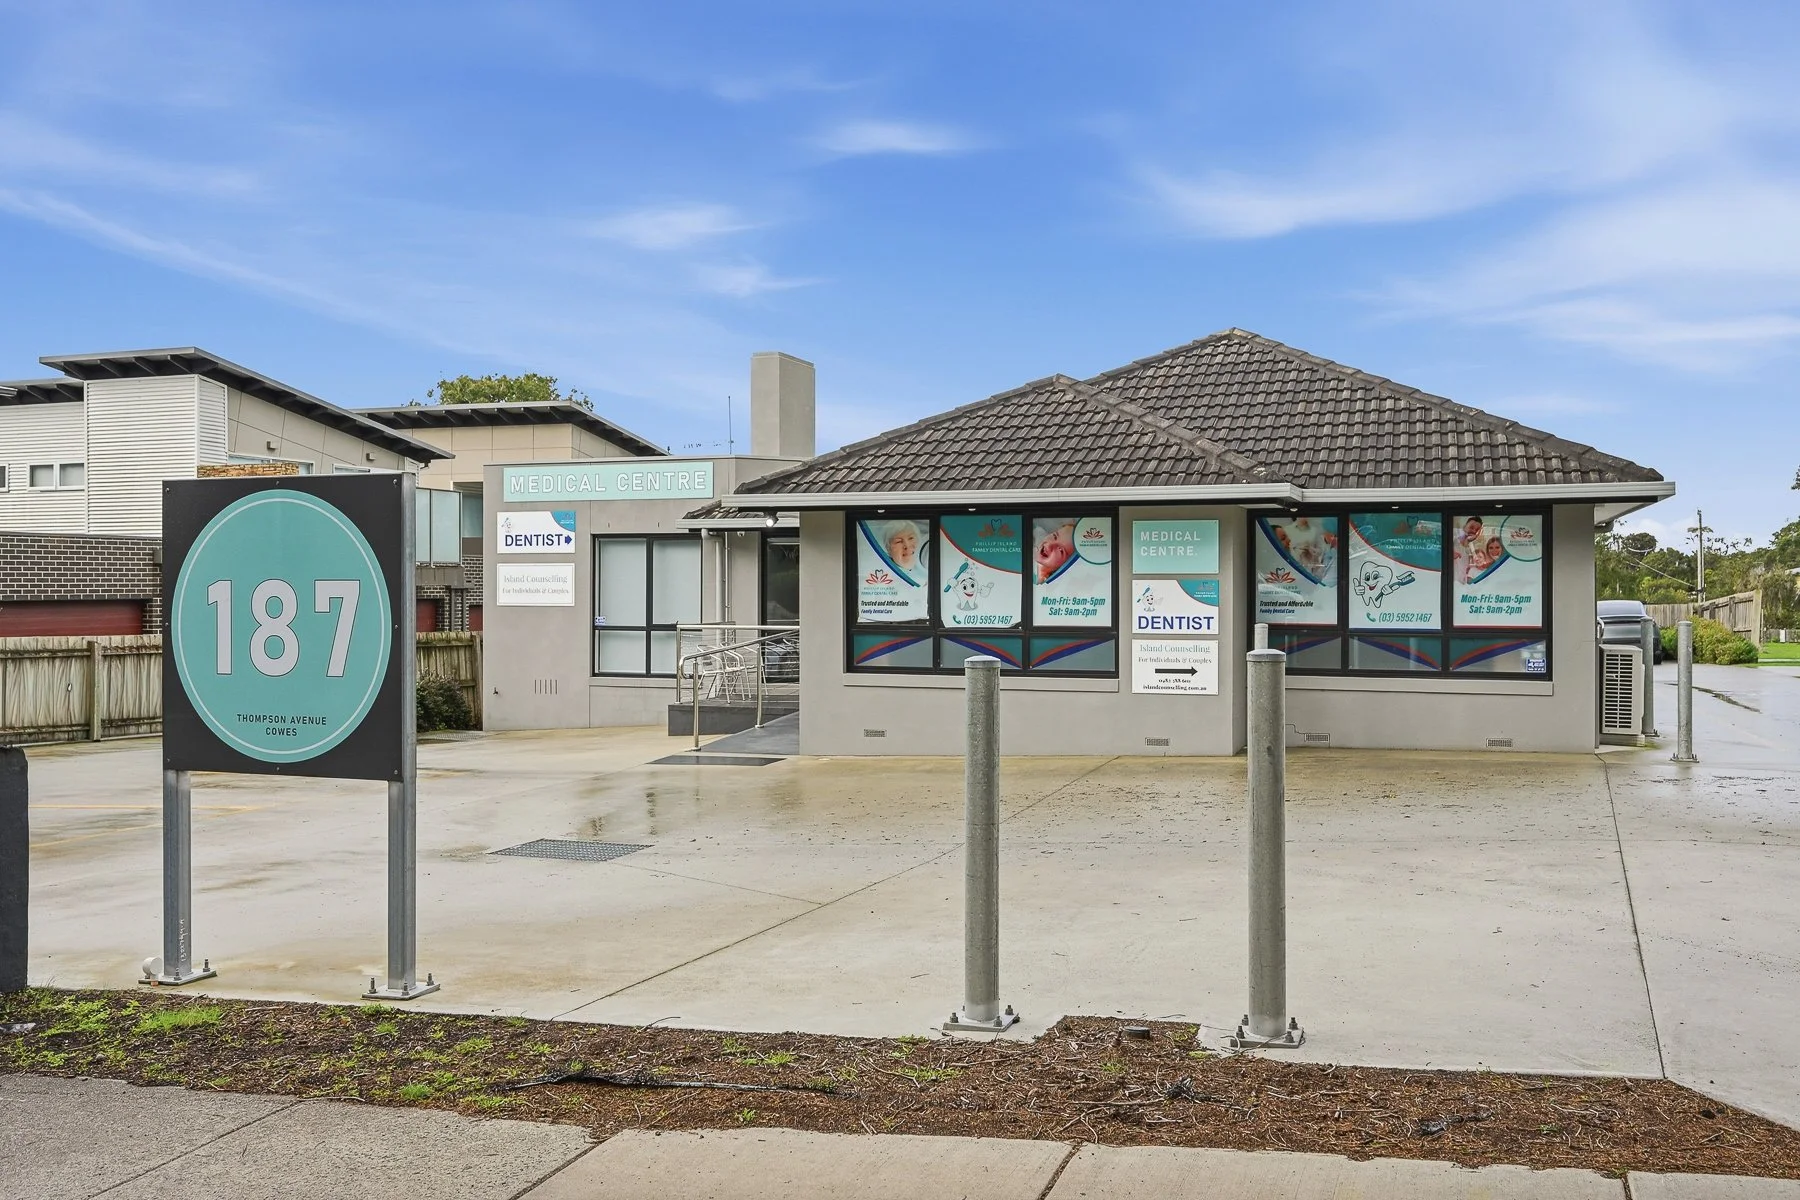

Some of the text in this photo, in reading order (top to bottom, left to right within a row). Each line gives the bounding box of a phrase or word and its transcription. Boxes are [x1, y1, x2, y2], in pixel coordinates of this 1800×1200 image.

[510, 470, 707, 494] MEDICAL CENTRE
[505, 533, 563, 547] DENTIST
[1140, 530, 1201, 541] MEDICAL
[504, 575, 568, 584] Island Counselling
[1041, 596, 1106, 607] Mon-Fri: 9am-5pm
[1460, 594, 1532, 605] Mon-Fri: 9am-5pm
[1048, 607, 1098, 618] Sat: 9am-2pm
[1469, 605, 1523, 616] Sat: 9am-2pm
[963, 614, 1013, 625] (03) 5952 1467
[1138, 615, 1215, 630] DENTIST
[1379, 612, 1433, 623] (03) 5952 1467
[207, 578, 361, 678] 187
[1140, 644, 1211, 653] Island Counselling
[1188, 657, 1212, 665] Couples
[236, 713, 327, 726] THOMPSON AVENUE
[265, 727, 298, 737] COWES
